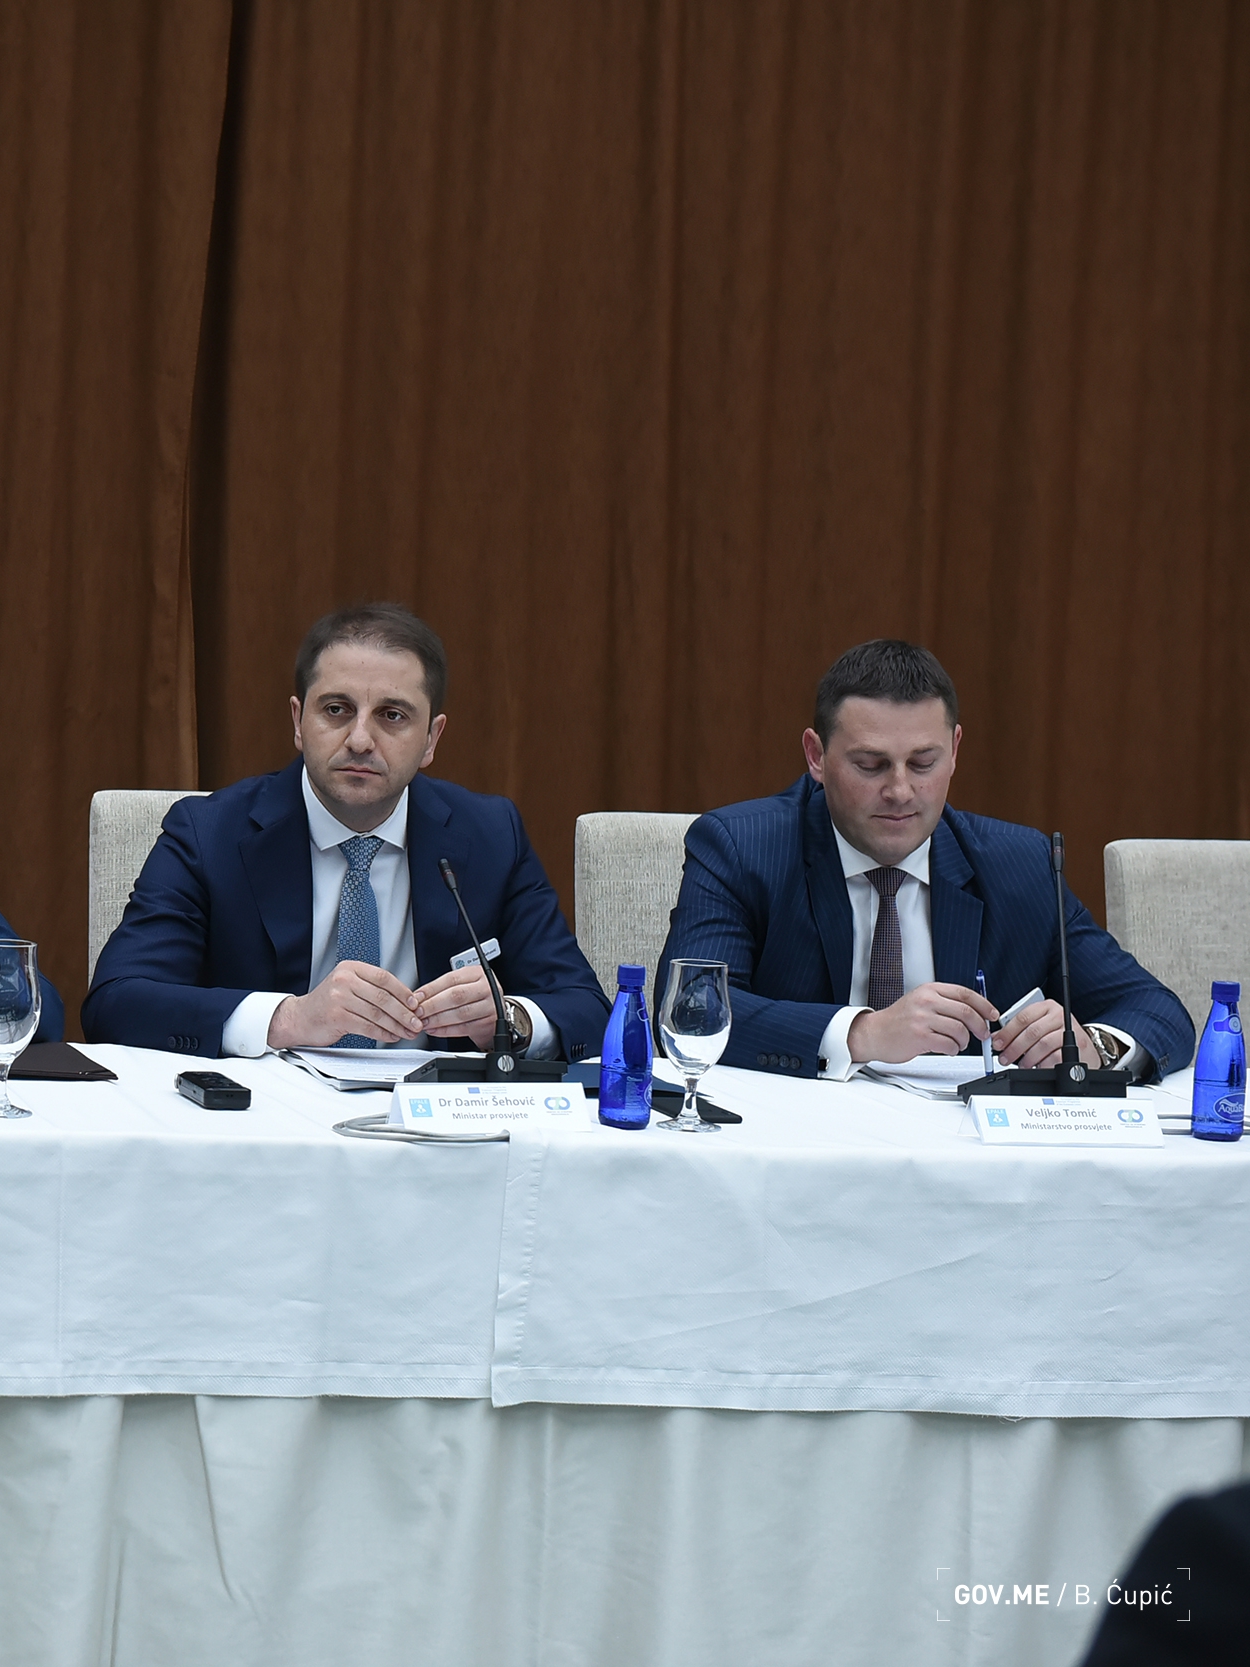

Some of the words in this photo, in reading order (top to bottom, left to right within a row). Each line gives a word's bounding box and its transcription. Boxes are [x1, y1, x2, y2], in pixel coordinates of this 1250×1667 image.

[438, 1098, 451, 1107] Dr
[455, 1097, 489, 1107] Damir
[492, 1095, 535, 1106] Šehović
[452, 1112, 487, 1120] Ministar
[489, 1112, 529, 1121] prosvjete
[1025, 1108, 1061, 1119] Veljko
[1064, 1108, 1098, 1118] Tomić
[1021, 1122, 1072, 1131] Ministarstvo
[1074, 1123, 1113, 1132] prosvjete
